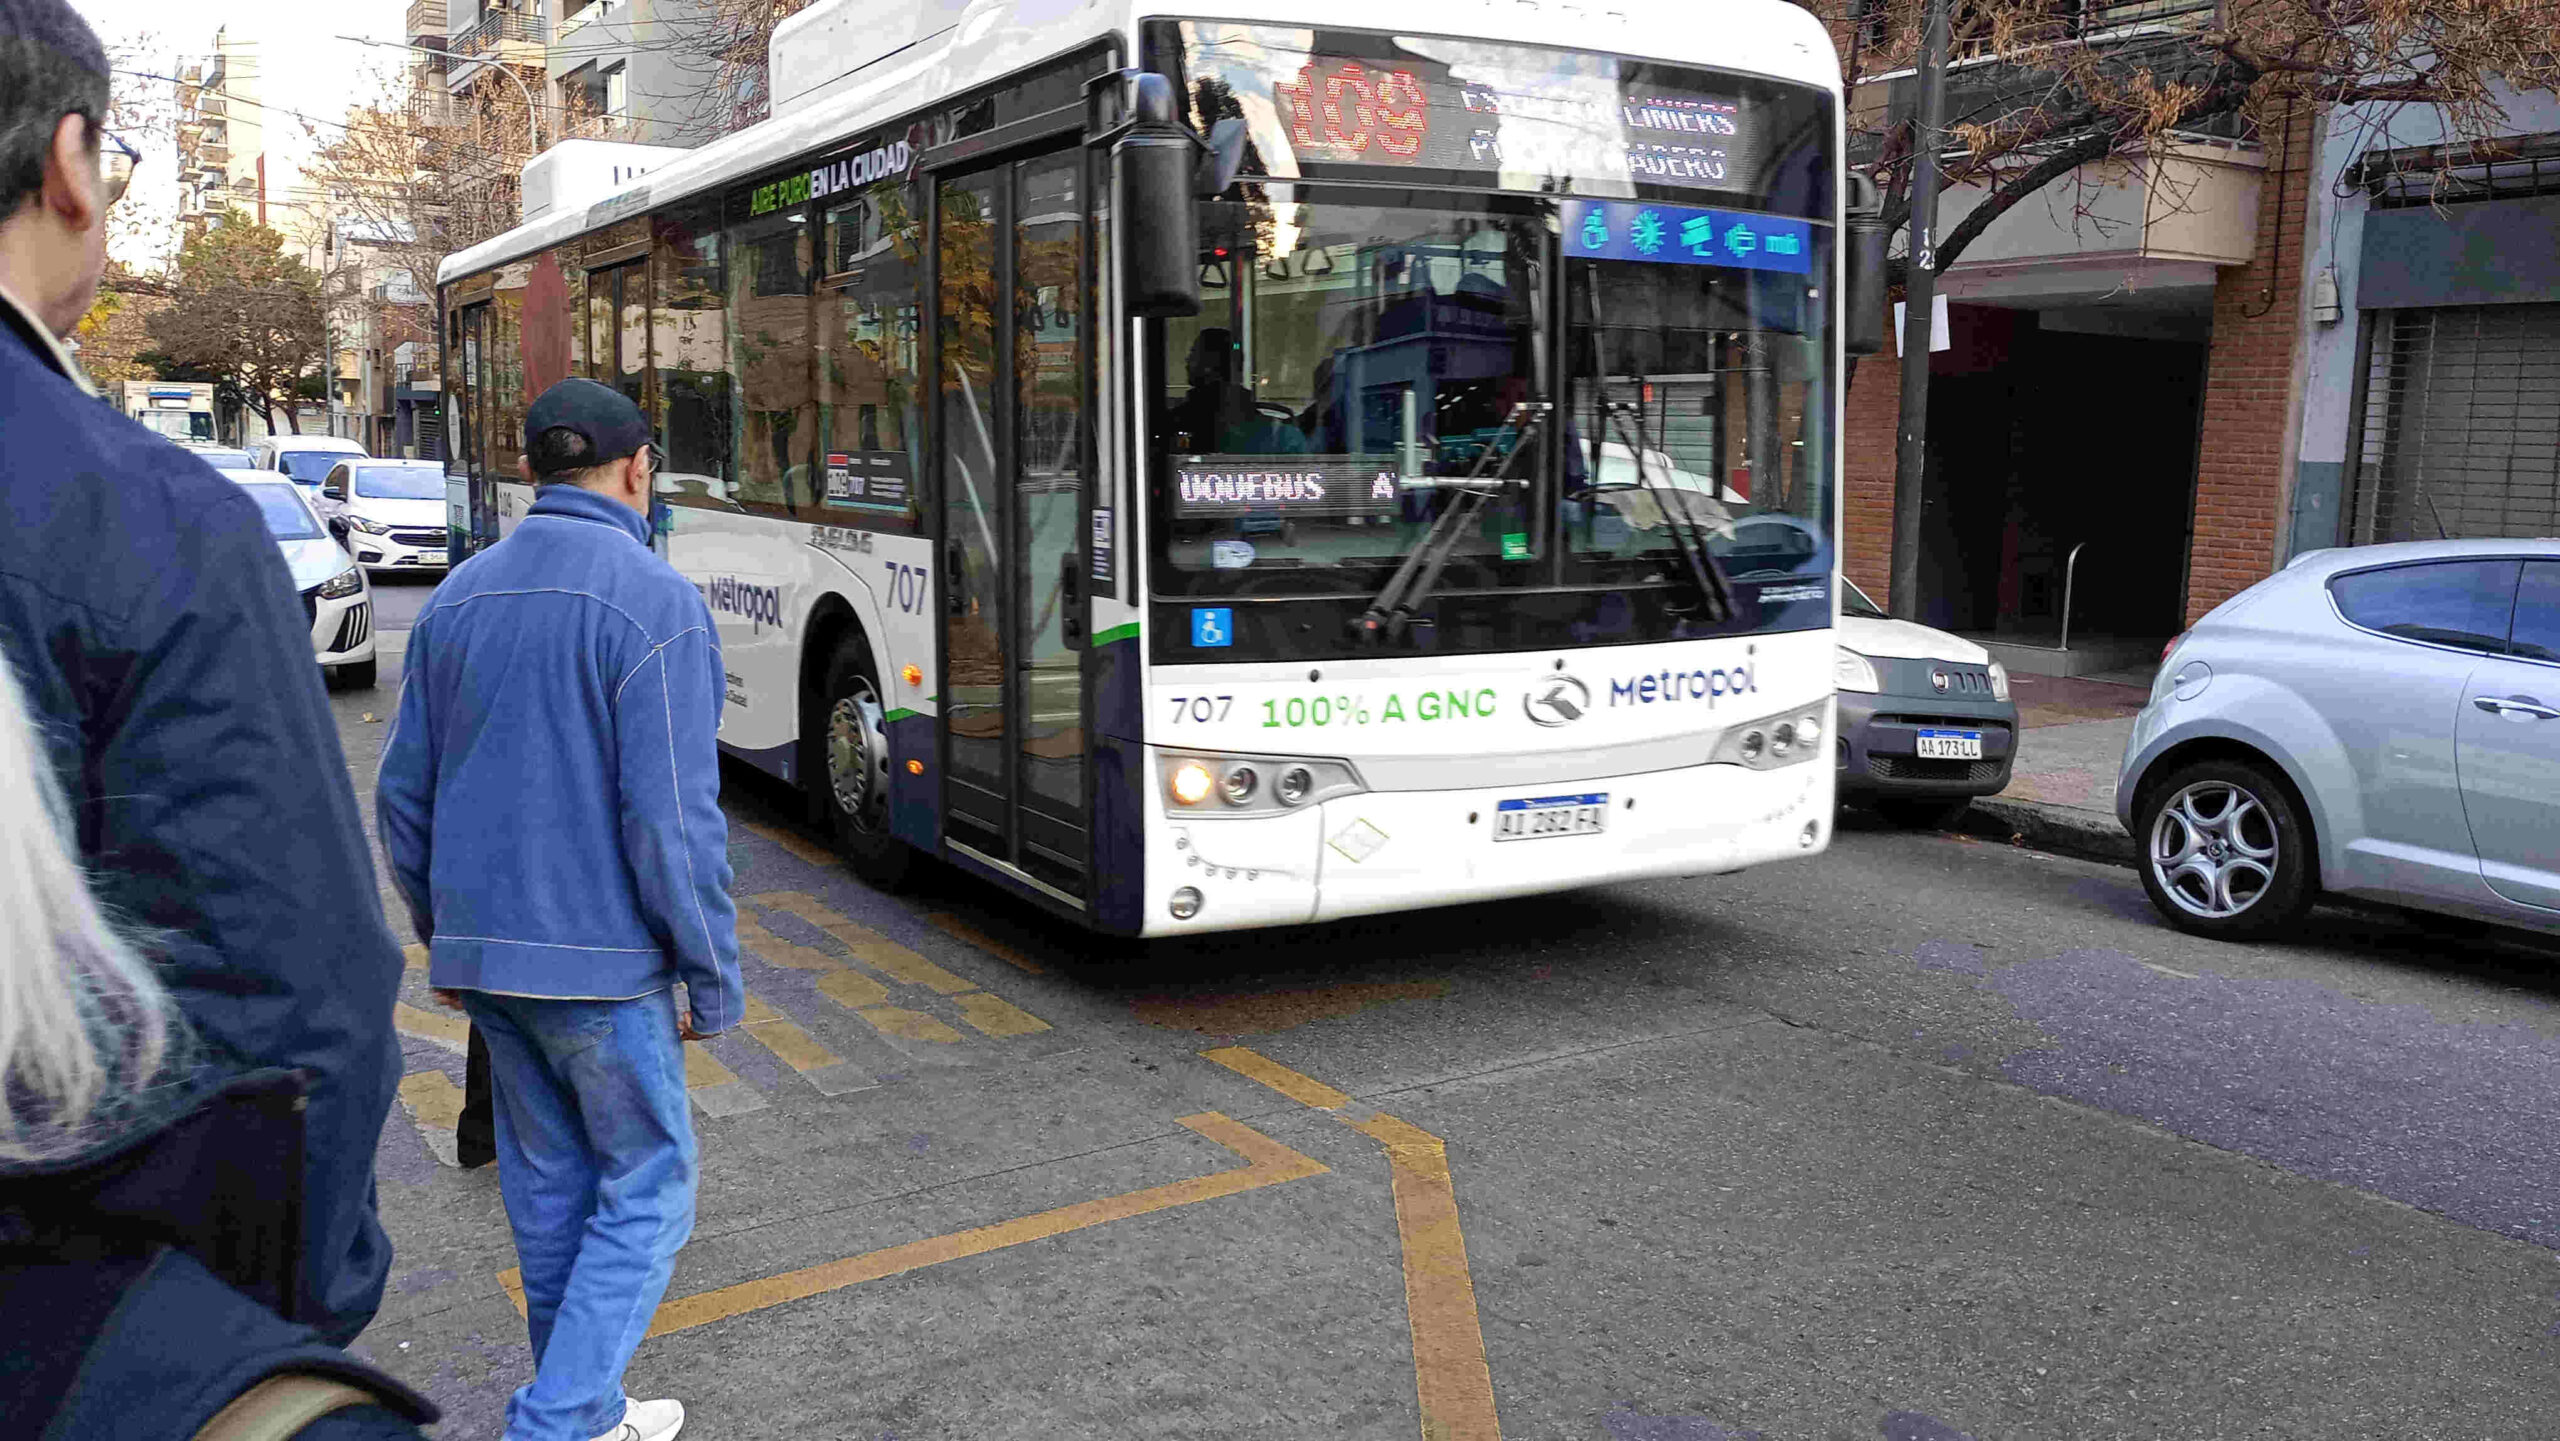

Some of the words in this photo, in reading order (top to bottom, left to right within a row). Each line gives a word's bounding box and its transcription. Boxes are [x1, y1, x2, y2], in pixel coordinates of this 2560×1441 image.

[1276, 62, 1426, 155] 109
[1622, 96, 1737, 136] LINIERS
[778, 172, 810, 208] PURO
[811, 166, 829, 199] EN
[830, 160, 850, 193] LA
[851, 140, 909, 187] CIUDAD
[1622, 142, 1727, 180] ADERO
[710, 574, 783, 635] Metropol
[885, 560, 927, 616] 707
[1170, 695, 1233, 724] 707
[1262, 694, 1369, 729] 100%
[1381, 693, 1406, 723] A
[1417, 688, 1497, 721] GNC
[1609, 662, 1757, 710] Metropol
[1921, 739, 1935, 755] AA
[1938, 740, 1959, 756] 173
